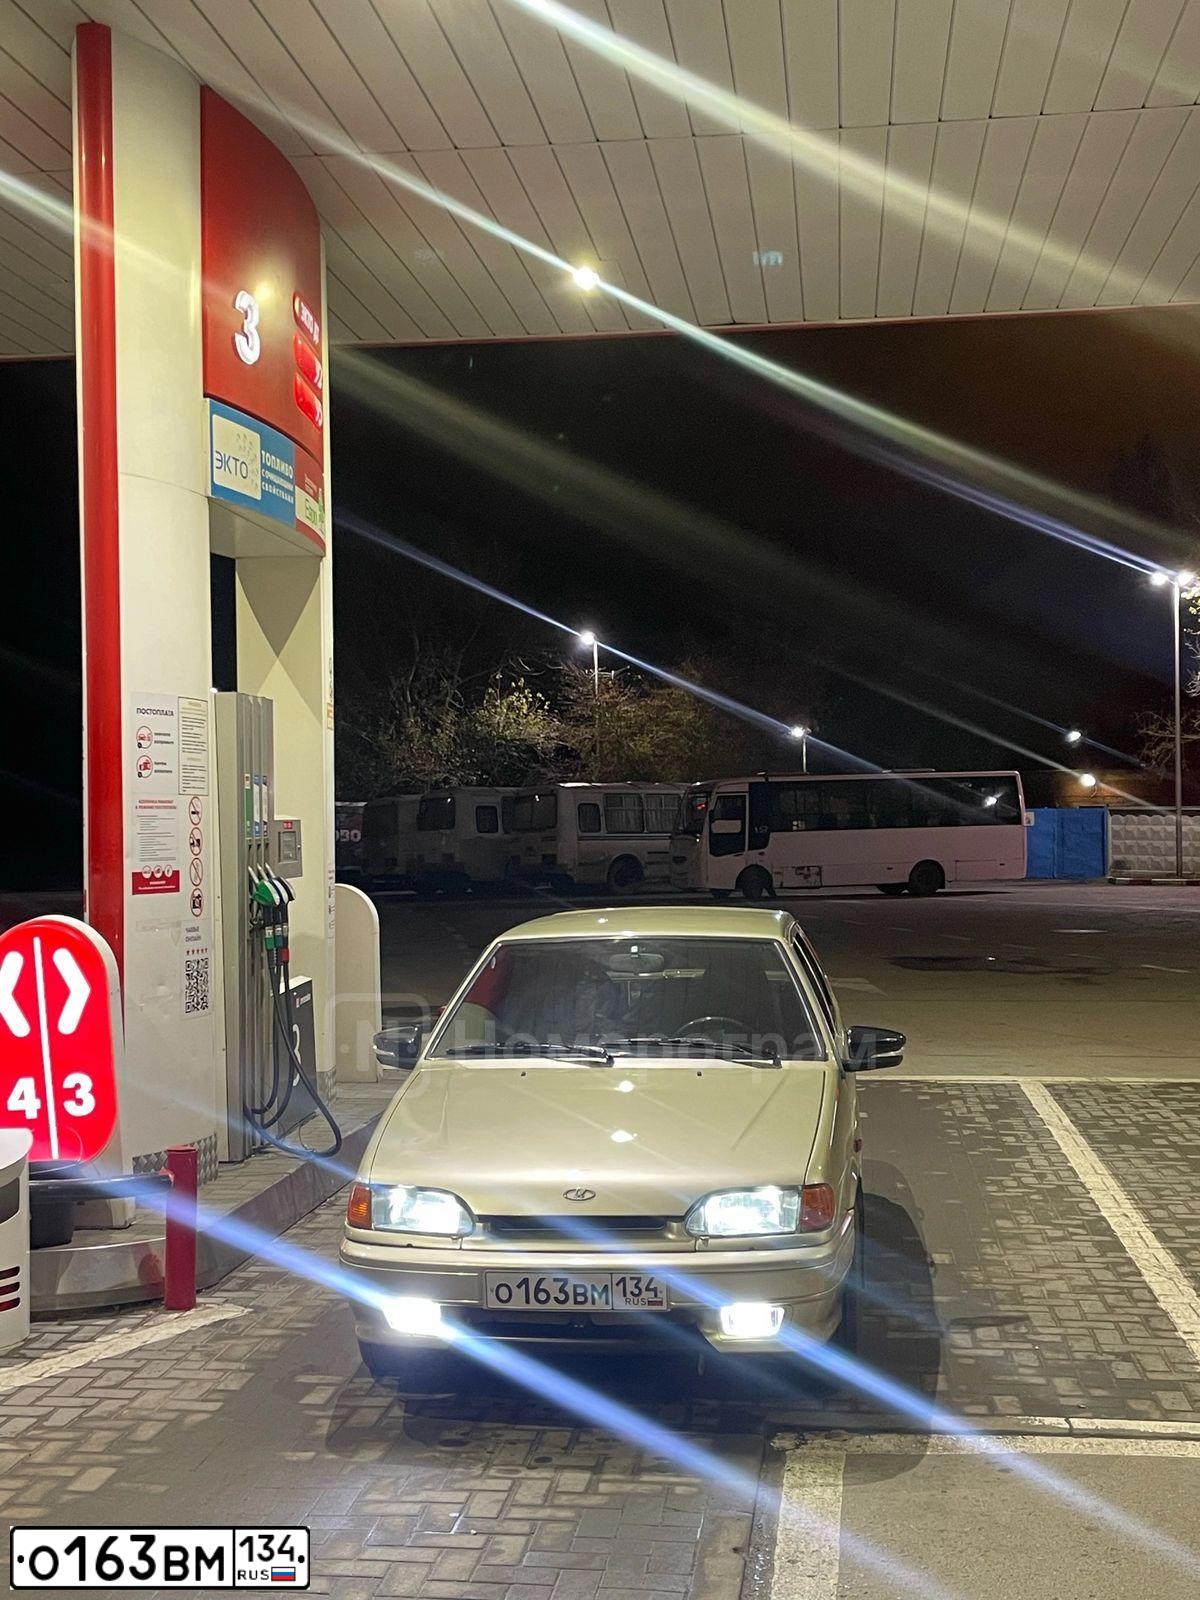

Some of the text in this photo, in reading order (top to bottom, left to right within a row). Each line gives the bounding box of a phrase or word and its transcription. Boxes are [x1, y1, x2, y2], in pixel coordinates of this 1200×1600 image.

[233, 290, 261, 365] 3
[215, 450, 249, 480] ЭКТО
[261, 449, 294, 480] ТОПЛИВО
[136, 707, 175, 717] ПОСТОПЛАТА
[7, 1073, 96, 1119] 4 3
[615, 1276, 658, 1298] 134
[624, 1297, 647, 1306] RUS
